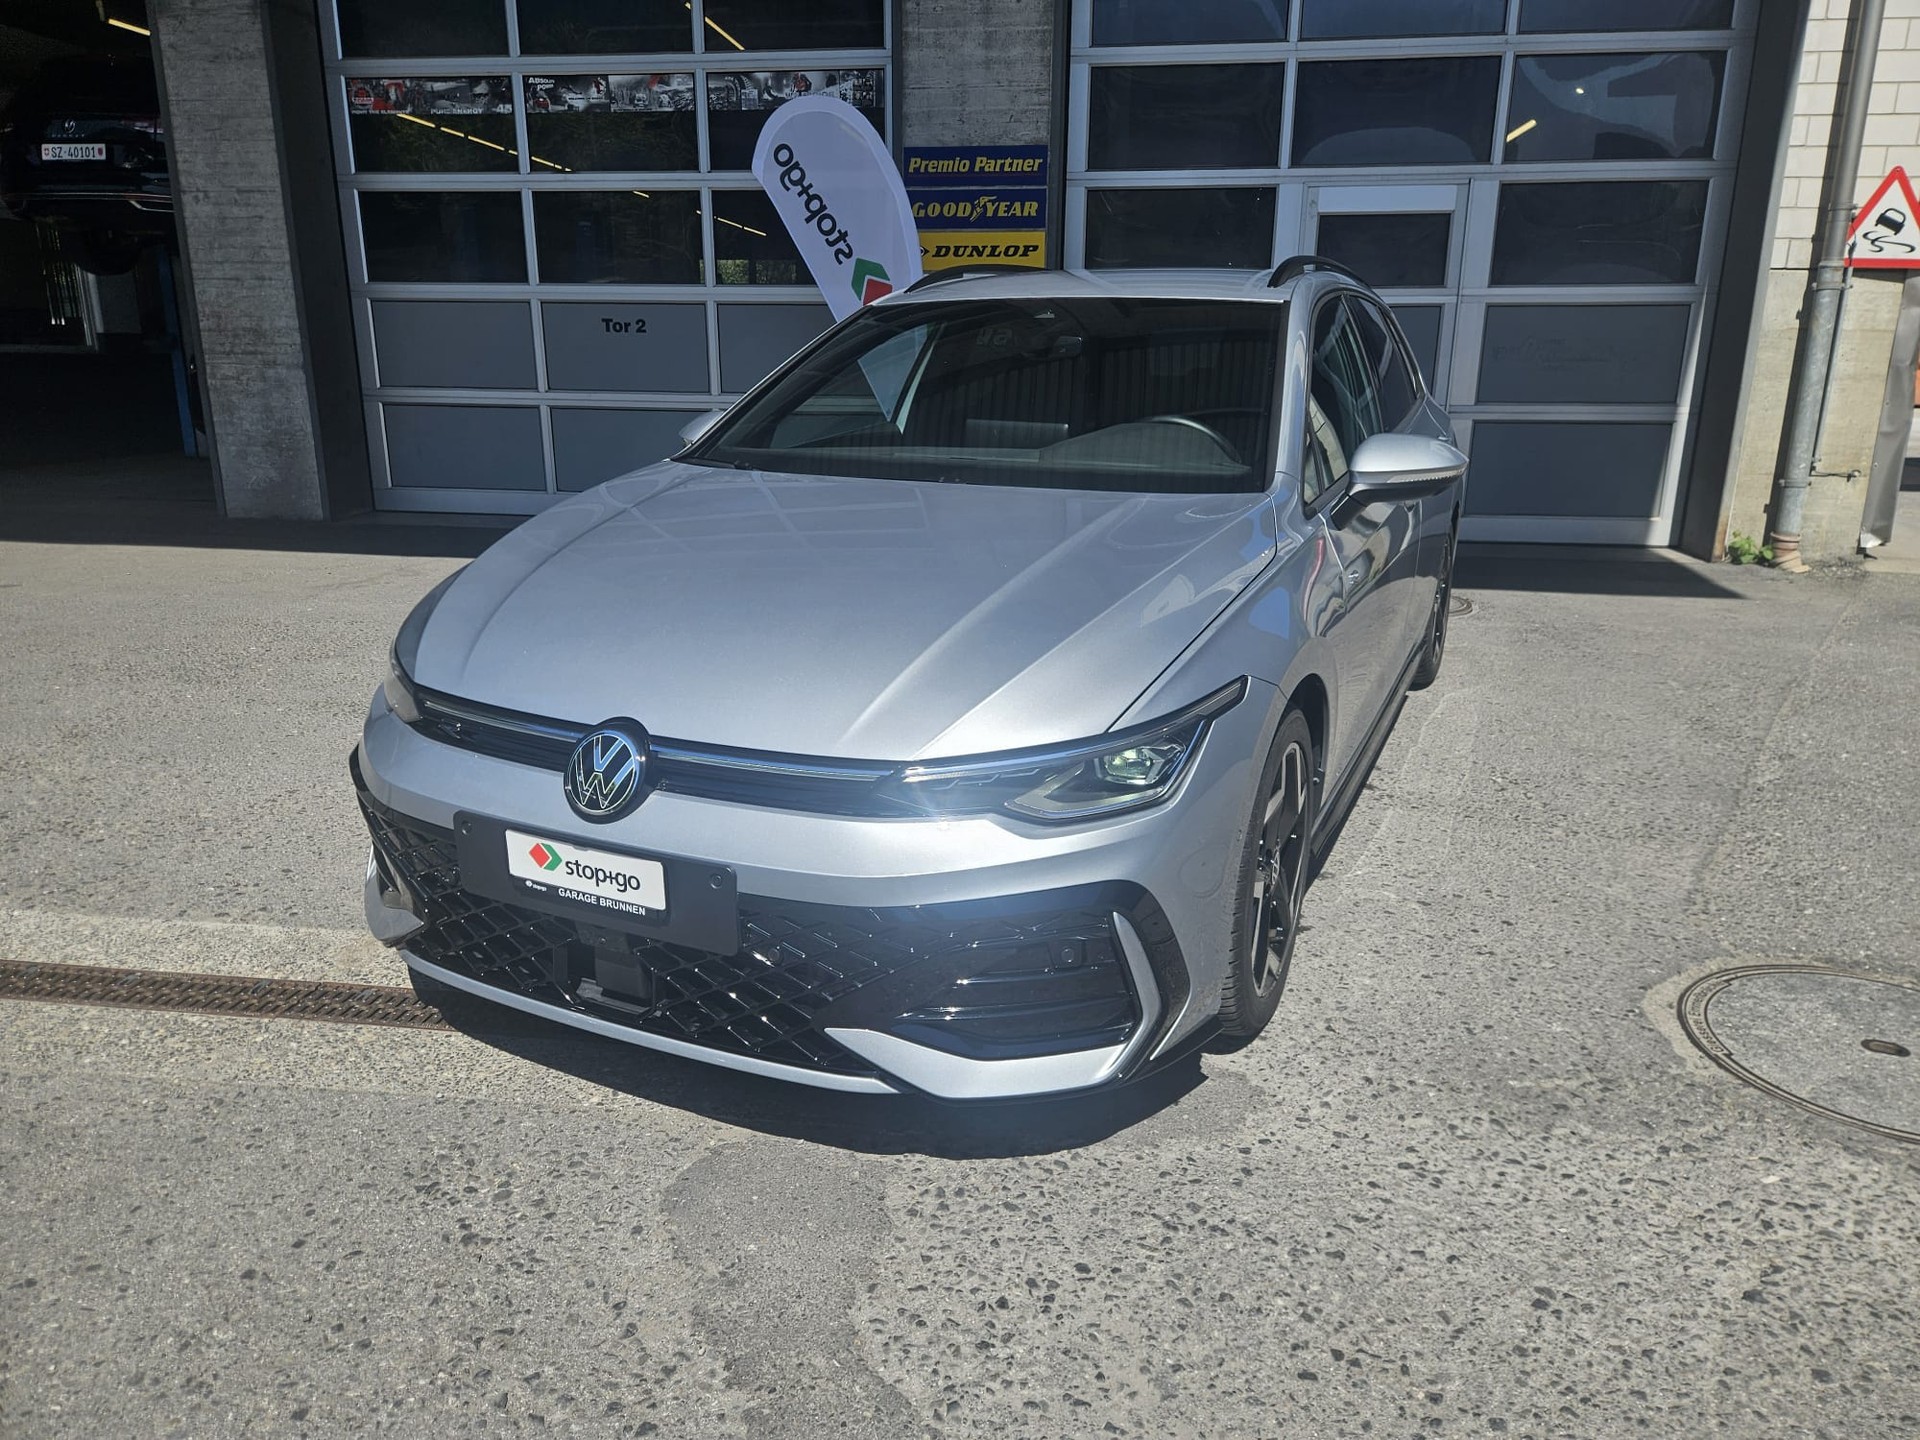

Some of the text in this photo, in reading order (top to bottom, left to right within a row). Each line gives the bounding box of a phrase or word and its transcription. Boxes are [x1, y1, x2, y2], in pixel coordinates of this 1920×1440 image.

[908, 156, 1043, 173] Premio Partner
[932, 244, 1039, 258] DUNLOP
[601, 317, 648, 334] Tor 2
[565, 859, 641, 893] stop+go
[558, 888, 646, 916] GARAGE BRUNNEN
